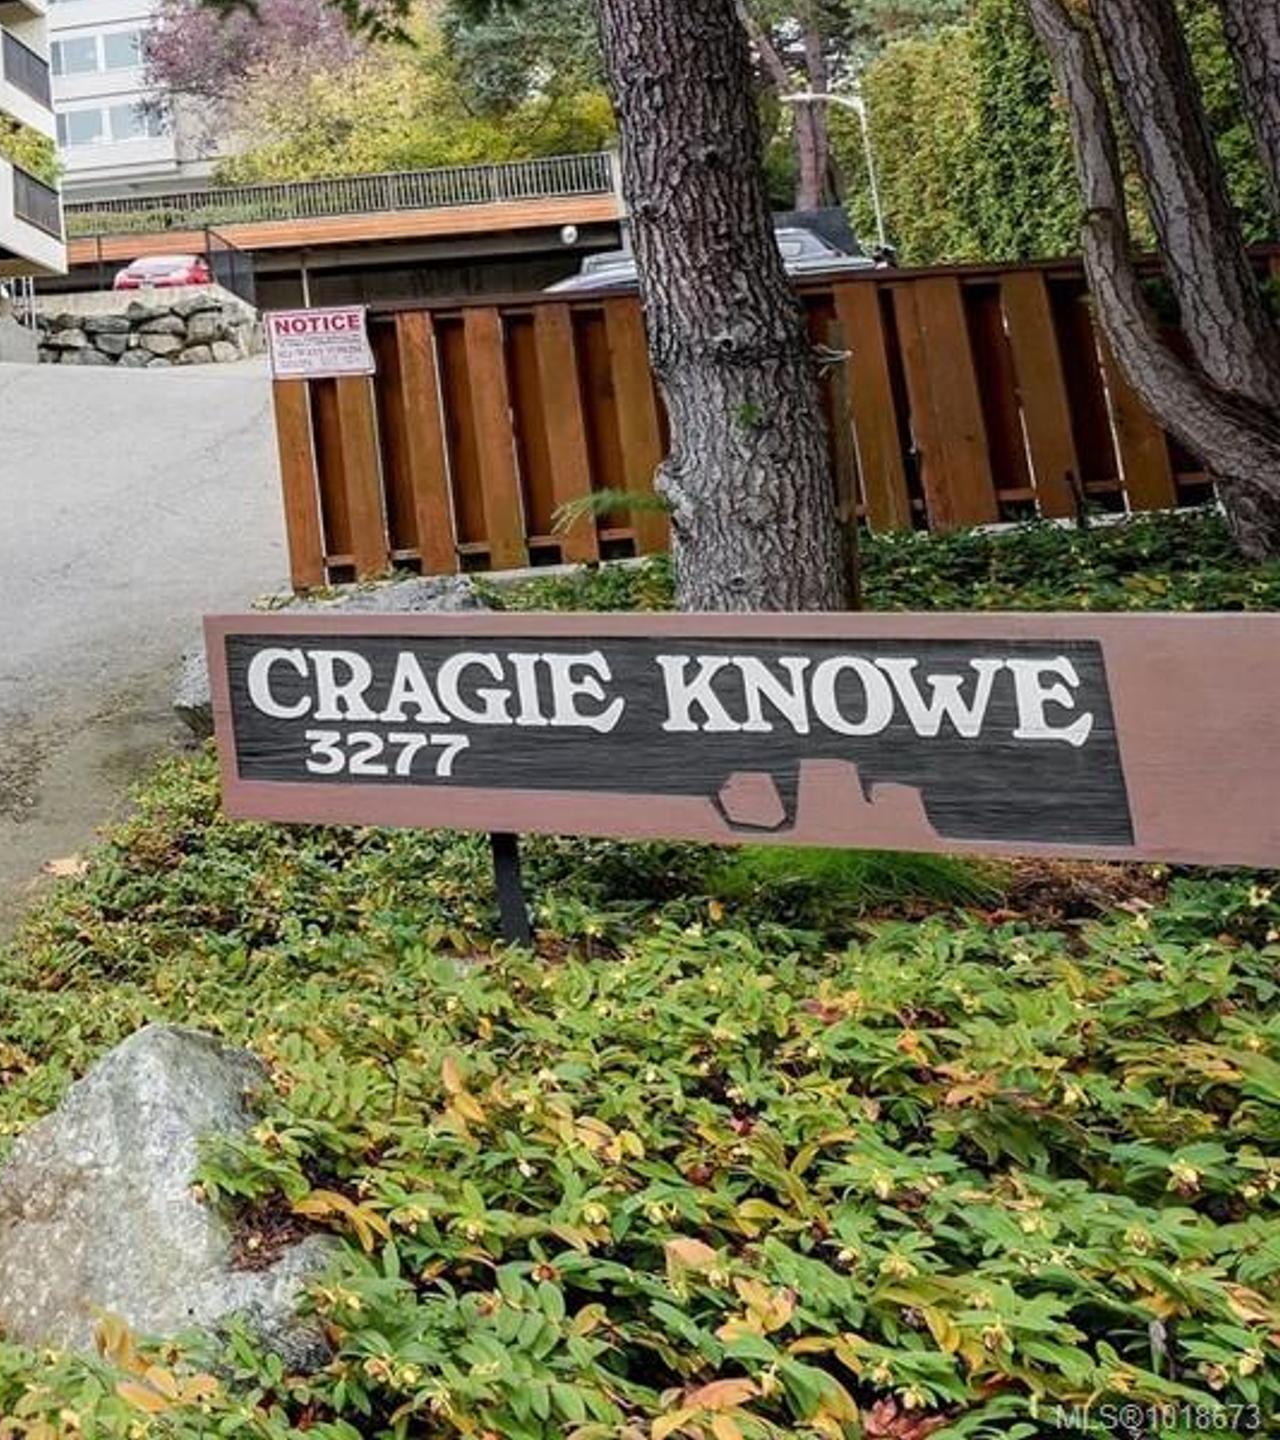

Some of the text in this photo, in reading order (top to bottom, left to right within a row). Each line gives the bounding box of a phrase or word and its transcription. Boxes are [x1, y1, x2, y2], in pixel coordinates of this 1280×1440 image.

[274, 314, 360, 334] NOTICE
[247, 648, 1094, 747] CRAGIE KNOWE
[304, 729, 470, 777] 3277
